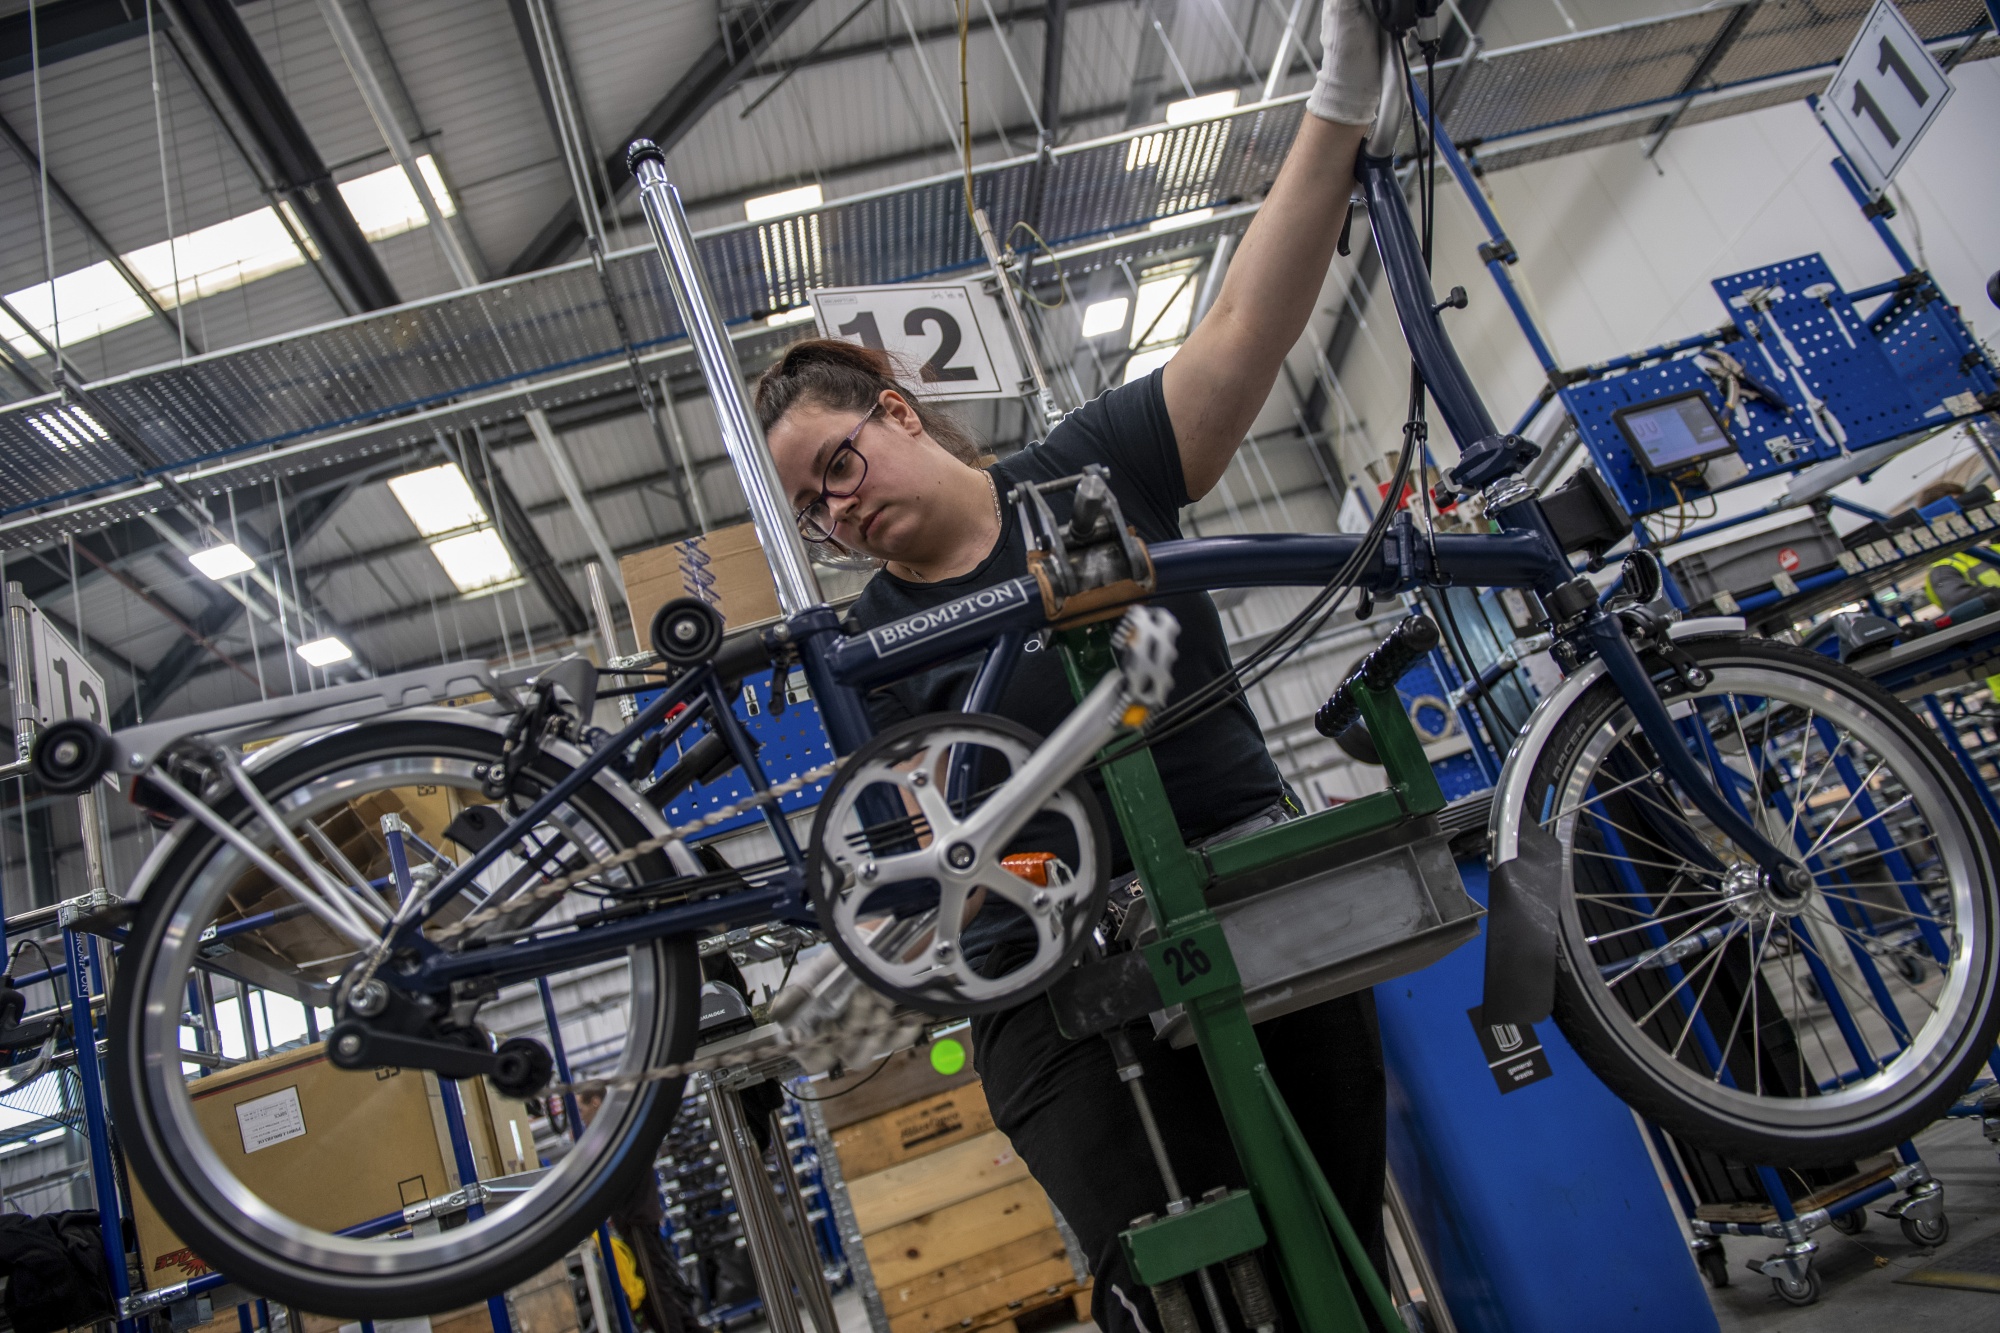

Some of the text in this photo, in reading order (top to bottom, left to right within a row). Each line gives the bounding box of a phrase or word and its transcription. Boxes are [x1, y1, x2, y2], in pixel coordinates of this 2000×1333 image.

[1852, 35, 1930, 149] 11
[838, 306, 978, 384] 12
[879, 585, 1014, 645] BROMPTON
[1552, 722, 1587, 780] RACER
[1163, 938, 1212, 987] 26
[1507, 1059, 1533, 1076] general
[1513, 1069, 1534, 1082] waste
